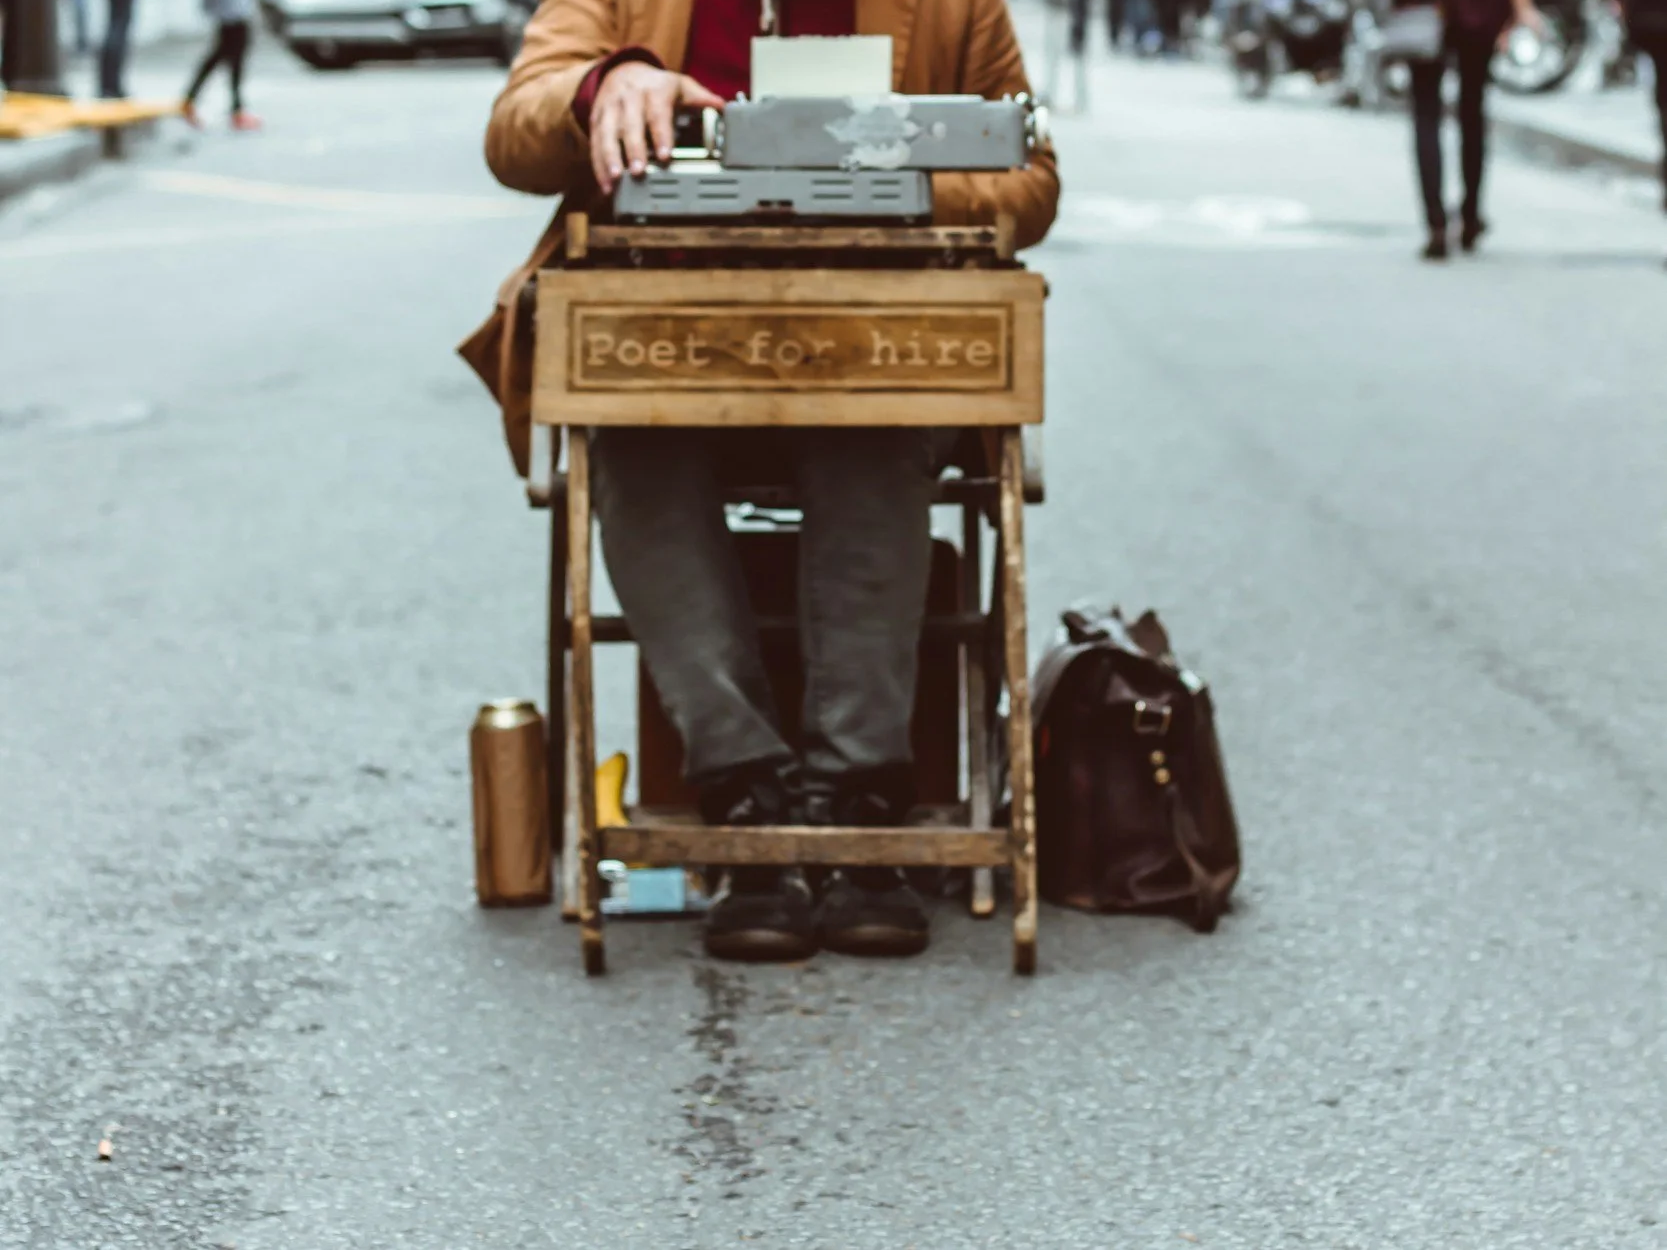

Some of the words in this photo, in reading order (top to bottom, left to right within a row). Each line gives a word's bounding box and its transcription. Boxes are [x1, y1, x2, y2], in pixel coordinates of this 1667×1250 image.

[586, 331, 709, 367] Poet
[748, 330, 836, 367] for
[870, 330, 994, 367] hire
